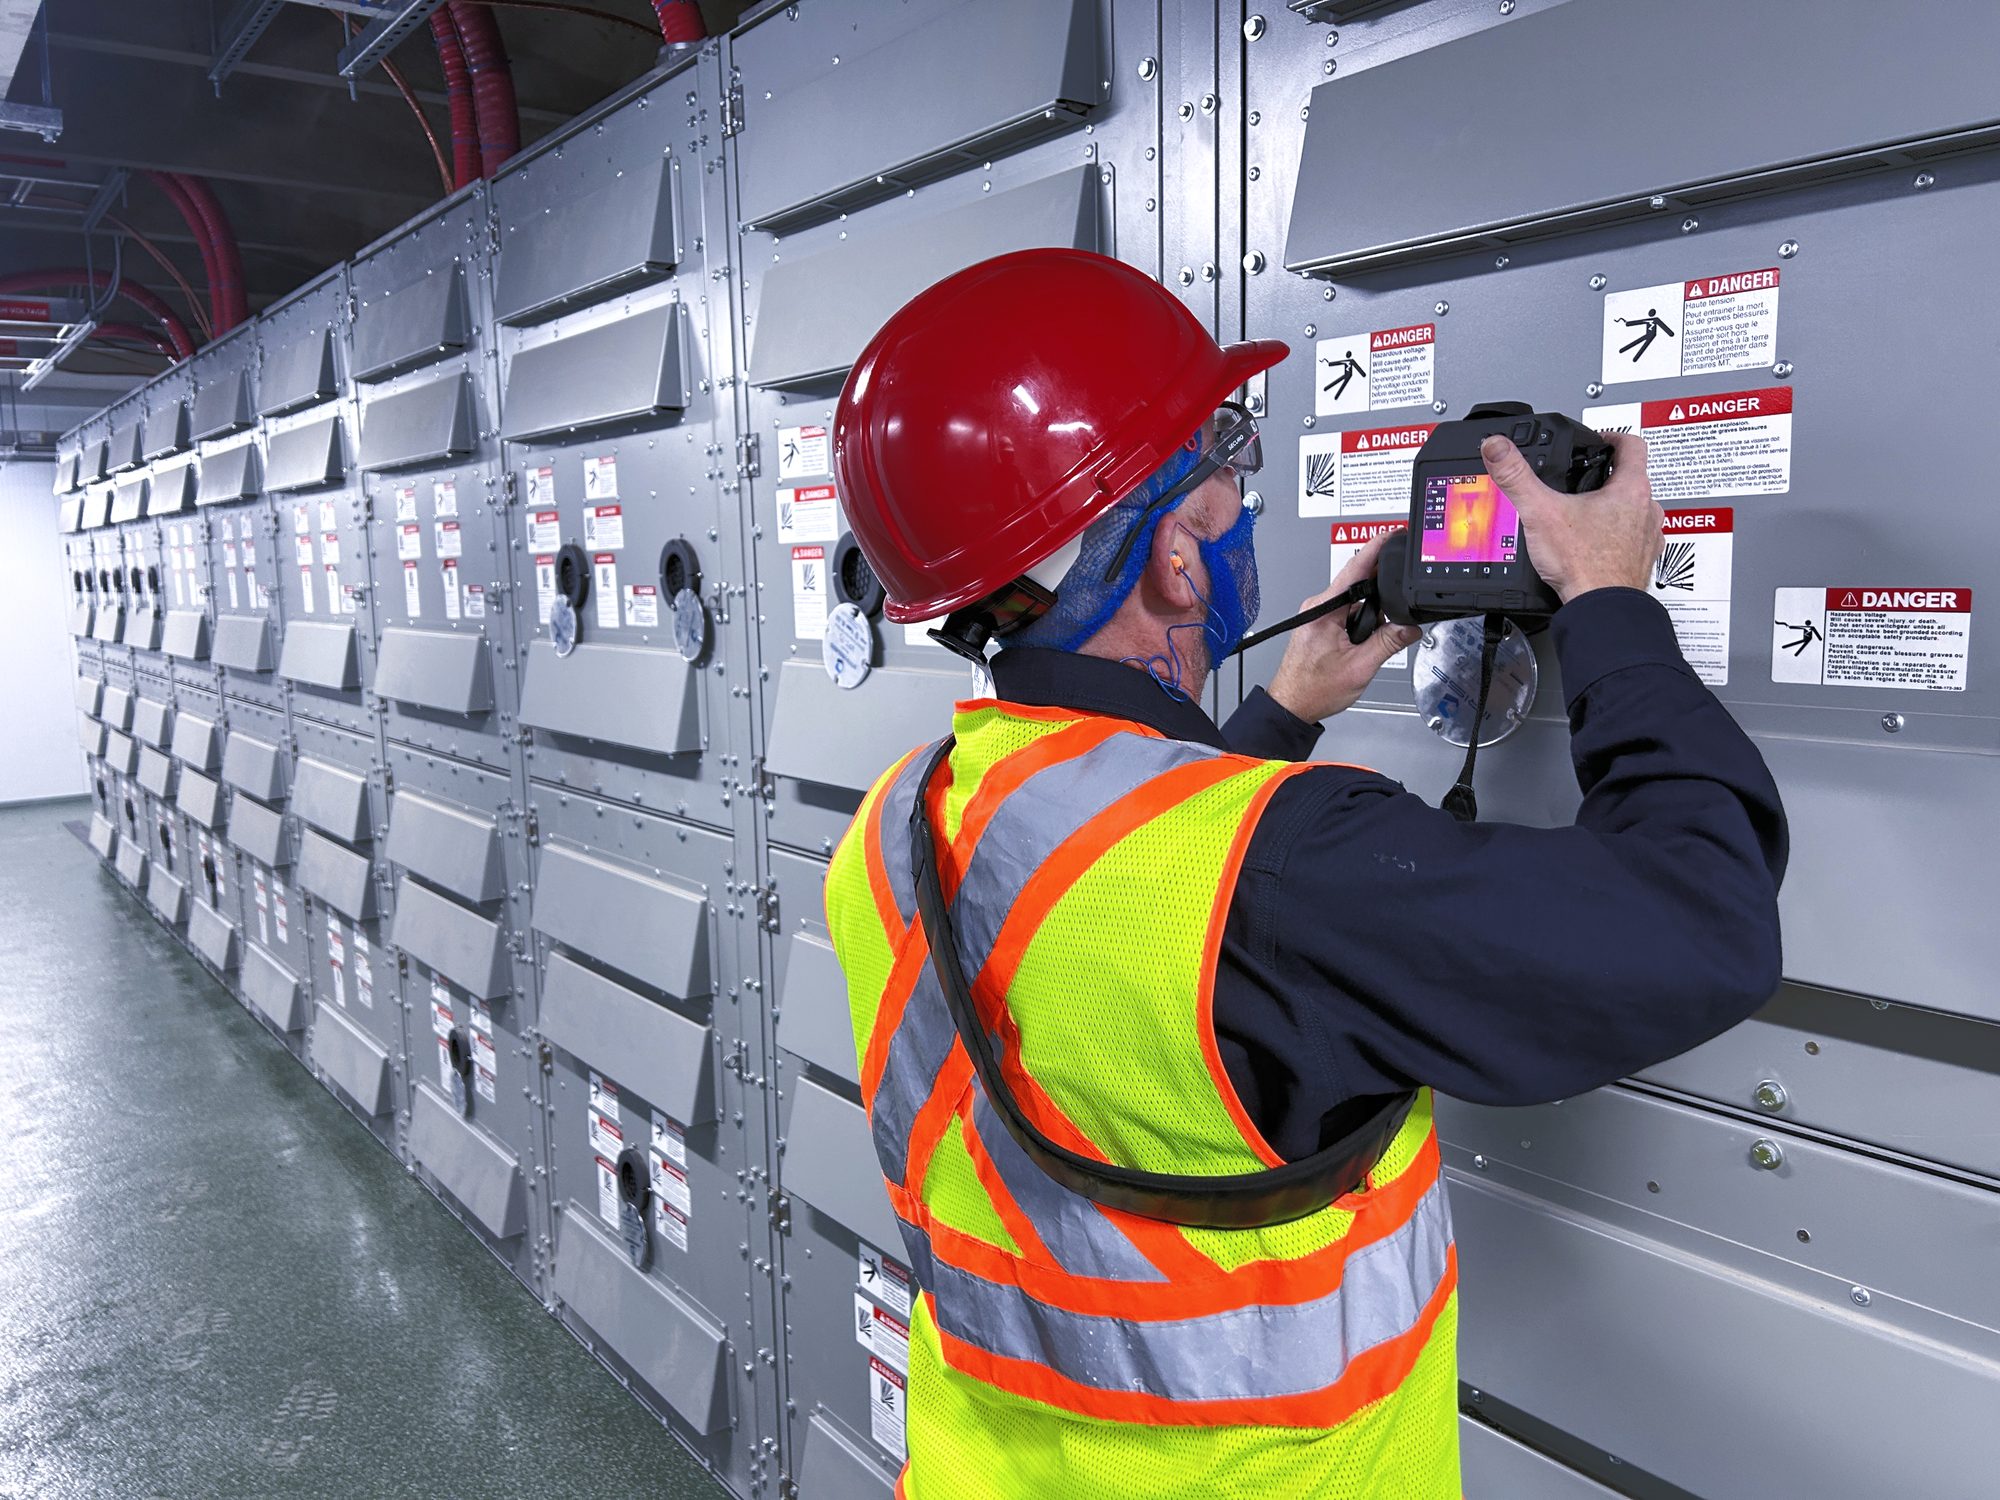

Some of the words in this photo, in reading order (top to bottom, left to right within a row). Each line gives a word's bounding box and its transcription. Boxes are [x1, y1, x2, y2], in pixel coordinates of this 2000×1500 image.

[1709, 271, 1773, 294] DANGER
[1685, 301, 1707, 310] Haute
[1708, 297, 1735, 306] tension
[1685, 311, 1702, 319] Peut
[1746, 302, 1764, 310] mort
[1707, 314, 1731, 324] graves
[1733, 309, 1769, 319] blessures
[1685, 324, 1734, 336] Assurez-vous
[1735, 322, 1750, 330] que
[1716, 331, 1730, 339] soit
[1731, 329, 1748, 337] hors
[1383, 327, 1431, 346] DANGER
[1683, 349, 1704, 357] avant
[1748, 341, 1768, 349] dans
[1684, 342, 1710, 350] tension
[1372, 350, 1402, 359] Hazardous
[1695, 350, 1750, 362] compartiments
[1682, 361, 1717, 371] primaires
[1412, 370, 1431, 379] ground
[1401, 379, 1429, 387] conductors
[1689, 398, 1759, 416] DANGER
[1372, 430, 1428, 447] DANGER
[805, 489, 829, 498] DANGER
[1662, 514, 1716, 529] ANGER
[799, 548, 823, 558] DANGER
[1862, 592, 1957, 608] DANGER
